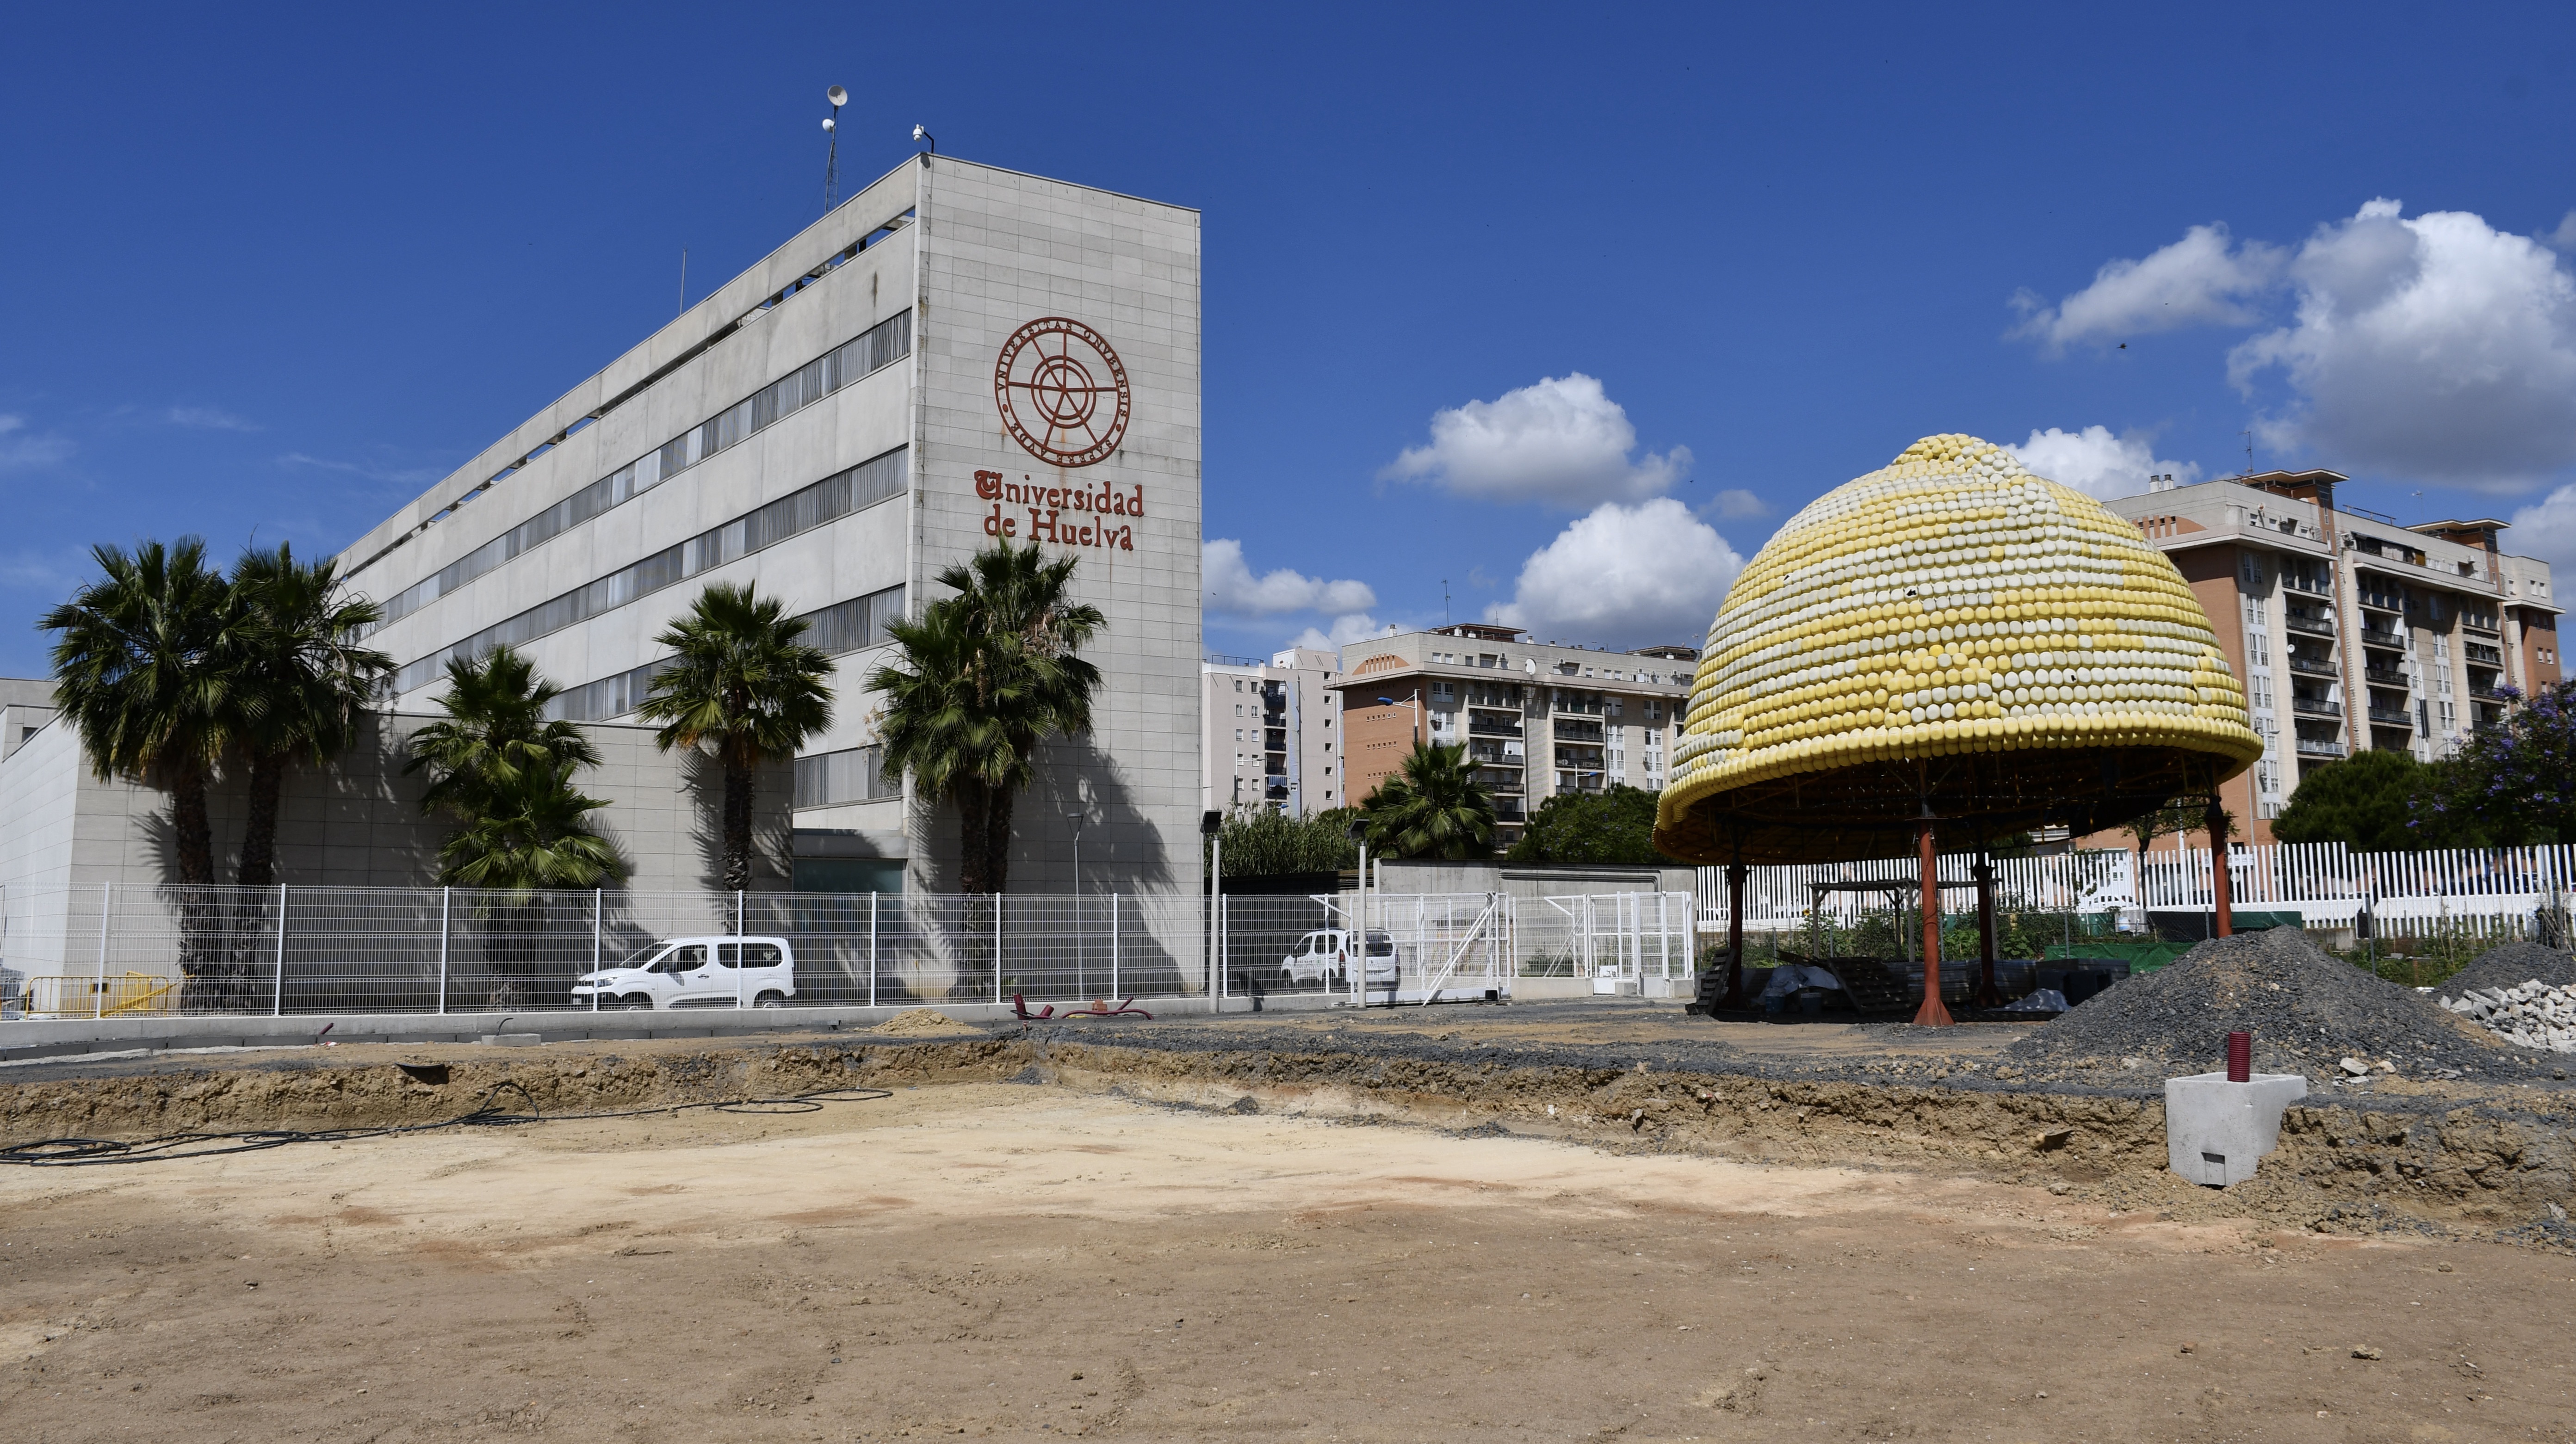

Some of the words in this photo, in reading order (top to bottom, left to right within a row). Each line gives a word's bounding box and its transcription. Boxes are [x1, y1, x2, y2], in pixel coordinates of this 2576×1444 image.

[997, 320, 1072, 391] VNIVERSITAS
[1084, 329, 1128, 417] ONVBENSIS
[1011, 423, 1047, 457] AVDE
[1057, 439, 1113, 463] SAPERE
[974, 469, 1144, 517] Universidad
[984, 504, 1016, 537] de
[1028, 507, 1134, 551] Huelva
